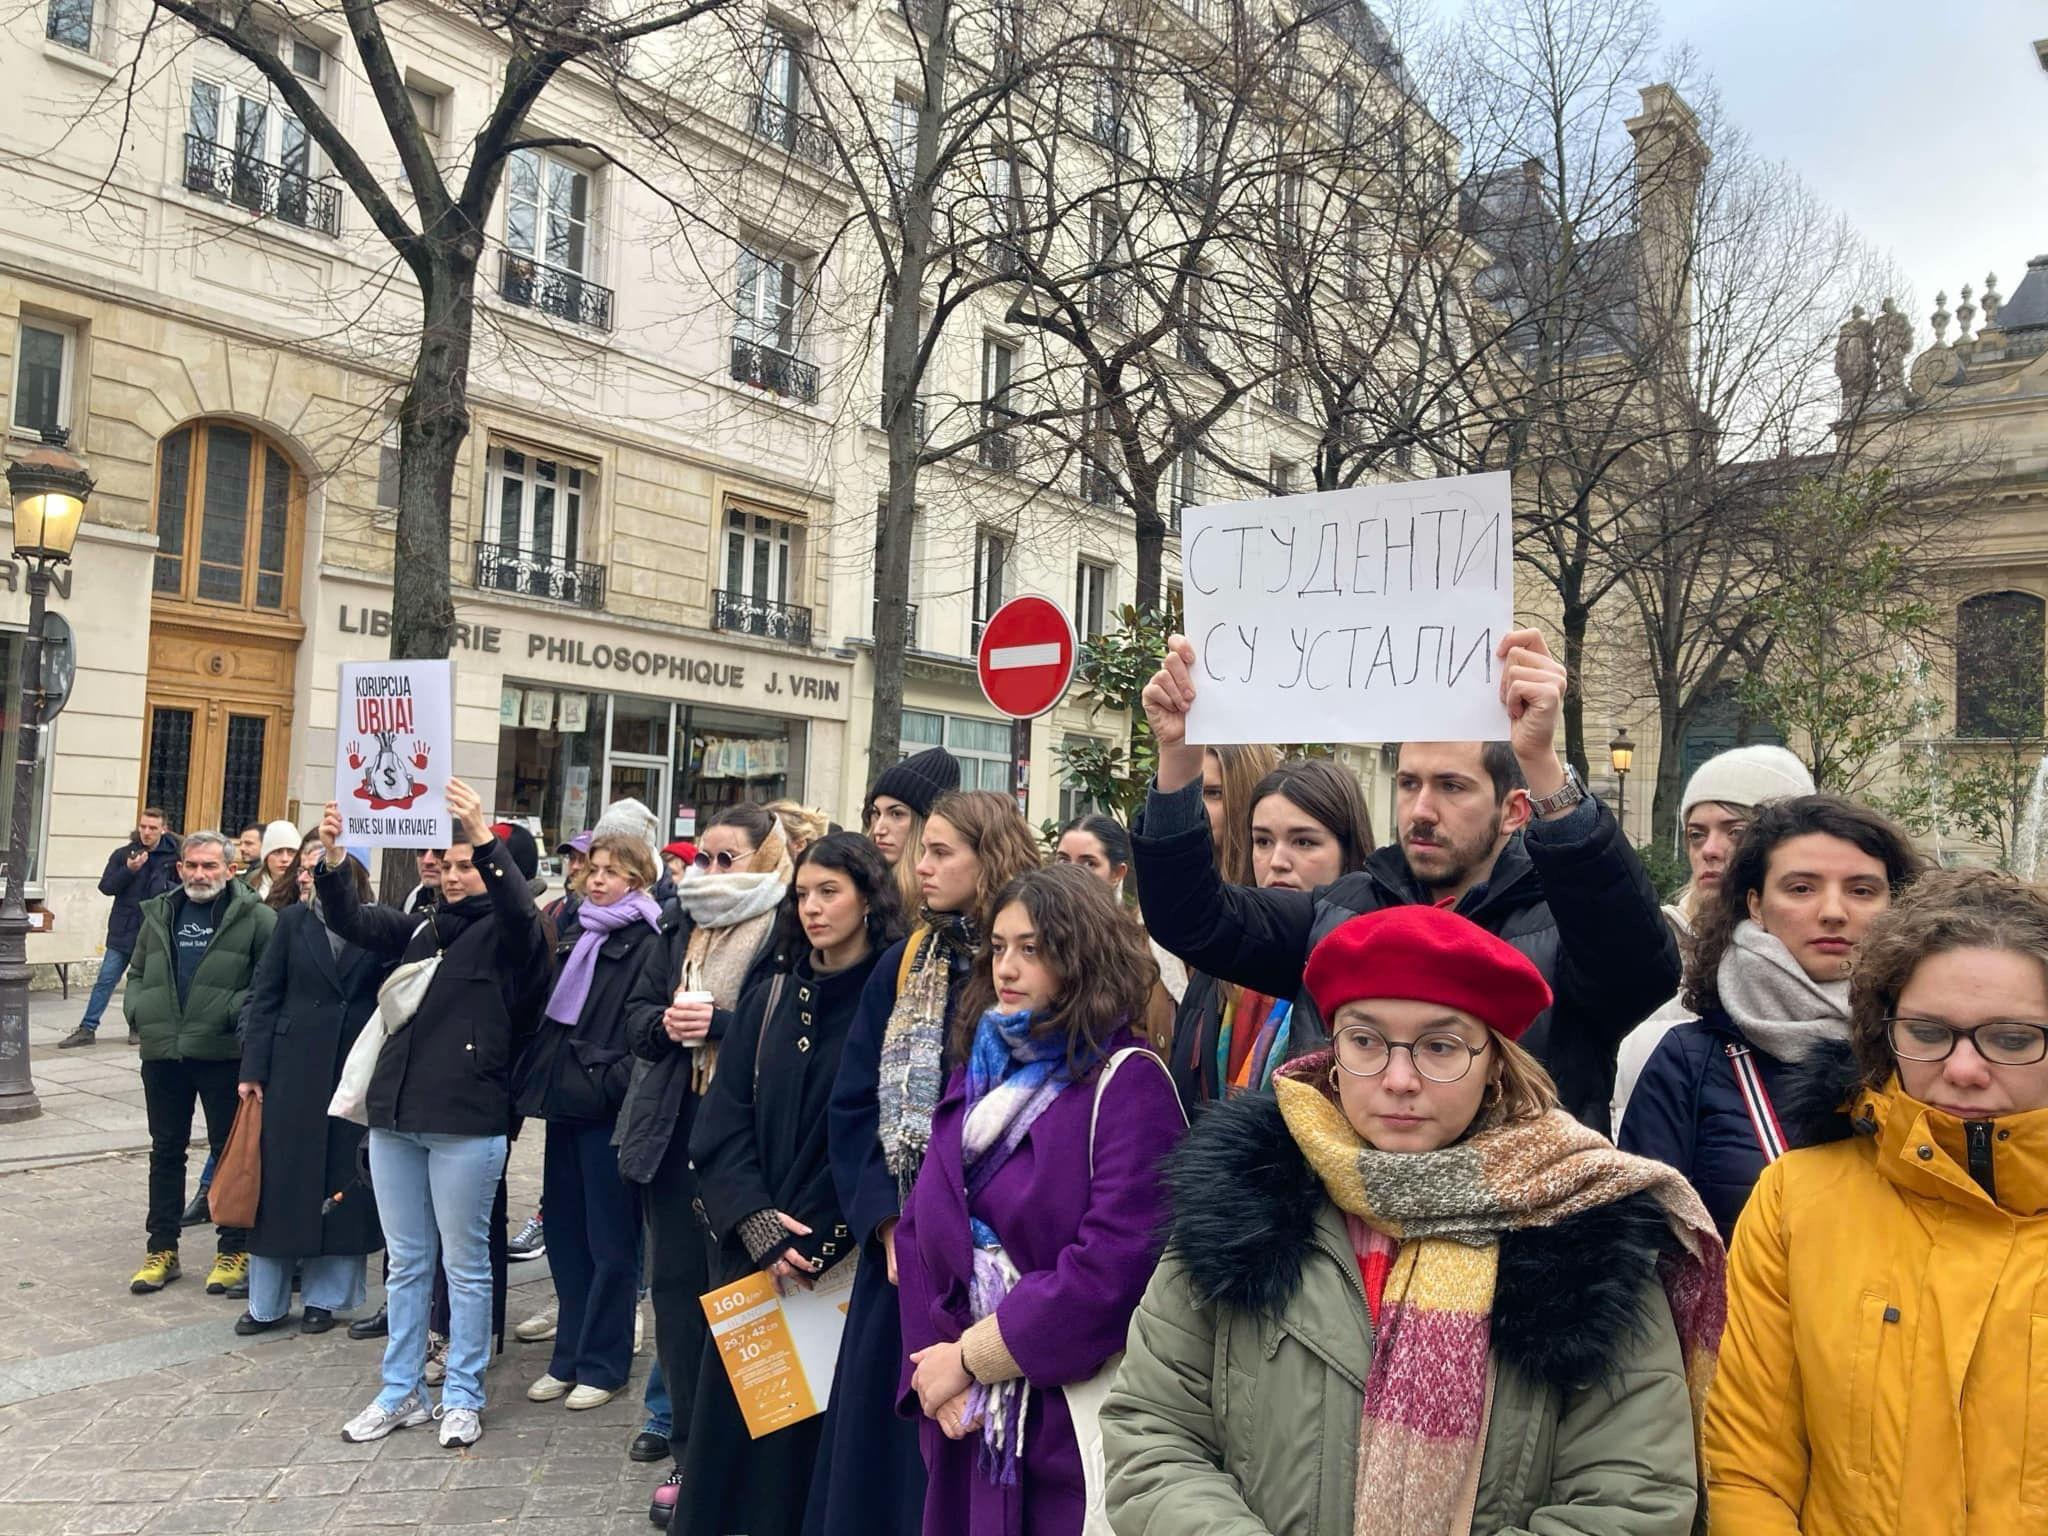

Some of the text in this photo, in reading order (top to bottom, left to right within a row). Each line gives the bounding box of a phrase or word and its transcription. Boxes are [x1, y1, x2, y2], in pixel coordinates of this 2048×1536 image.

[1190, 510, 1500, 598] СТУДЕНТИ
[211, 656, 222, 673] 6
[339, 604, 840, 702] LIBRIE PHILOSOPHIQUE J. VRIN
[1204, 622, 1491, 691] СУ УСТАЛИ
[356, 676, 411, 697] KORUPCIJA
[357, 698, 414, 735] UBIJA!
[349, 817, 437, 835] RUKE SU IM KRVAVE!
[713, 1291, 745, 1315] 160
[723, 1334, 745, 1351] 29,7
[752, 1325, 767, 1337] 42
[739, 1343, 760, 1362] 10
